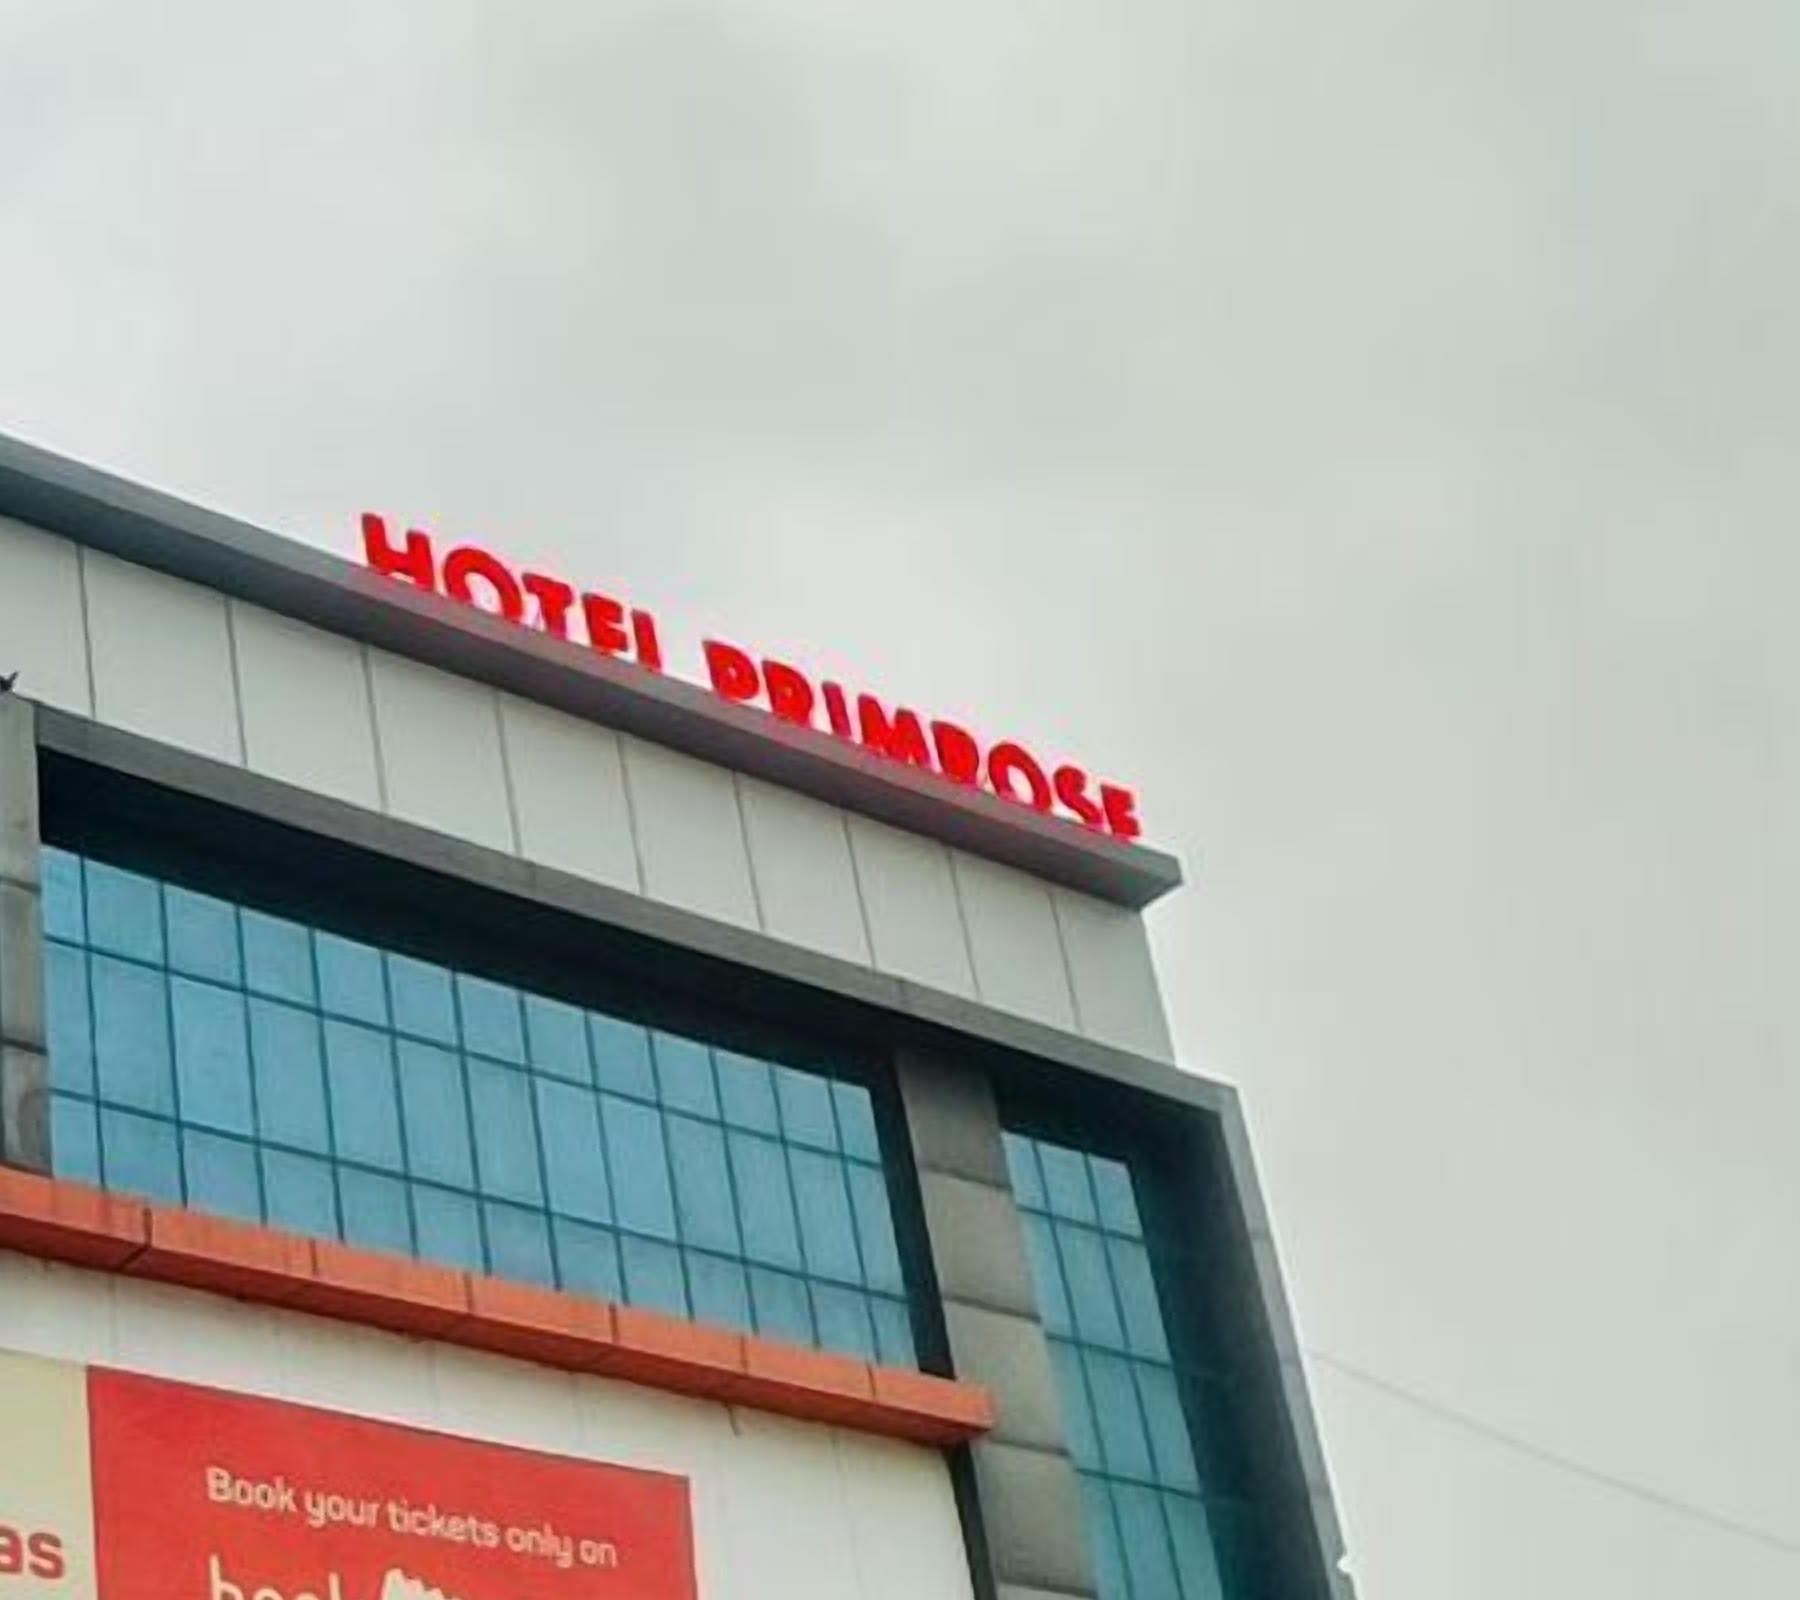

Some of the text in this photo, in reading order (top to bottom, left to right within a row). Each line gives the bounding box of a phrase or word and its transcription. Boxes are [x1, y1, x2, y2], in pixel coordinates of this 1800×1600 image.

[361, 512, 1140, 839] HOTEL PRIMROSE
[206, 1465, 618, 1568] Book your tickets only on
